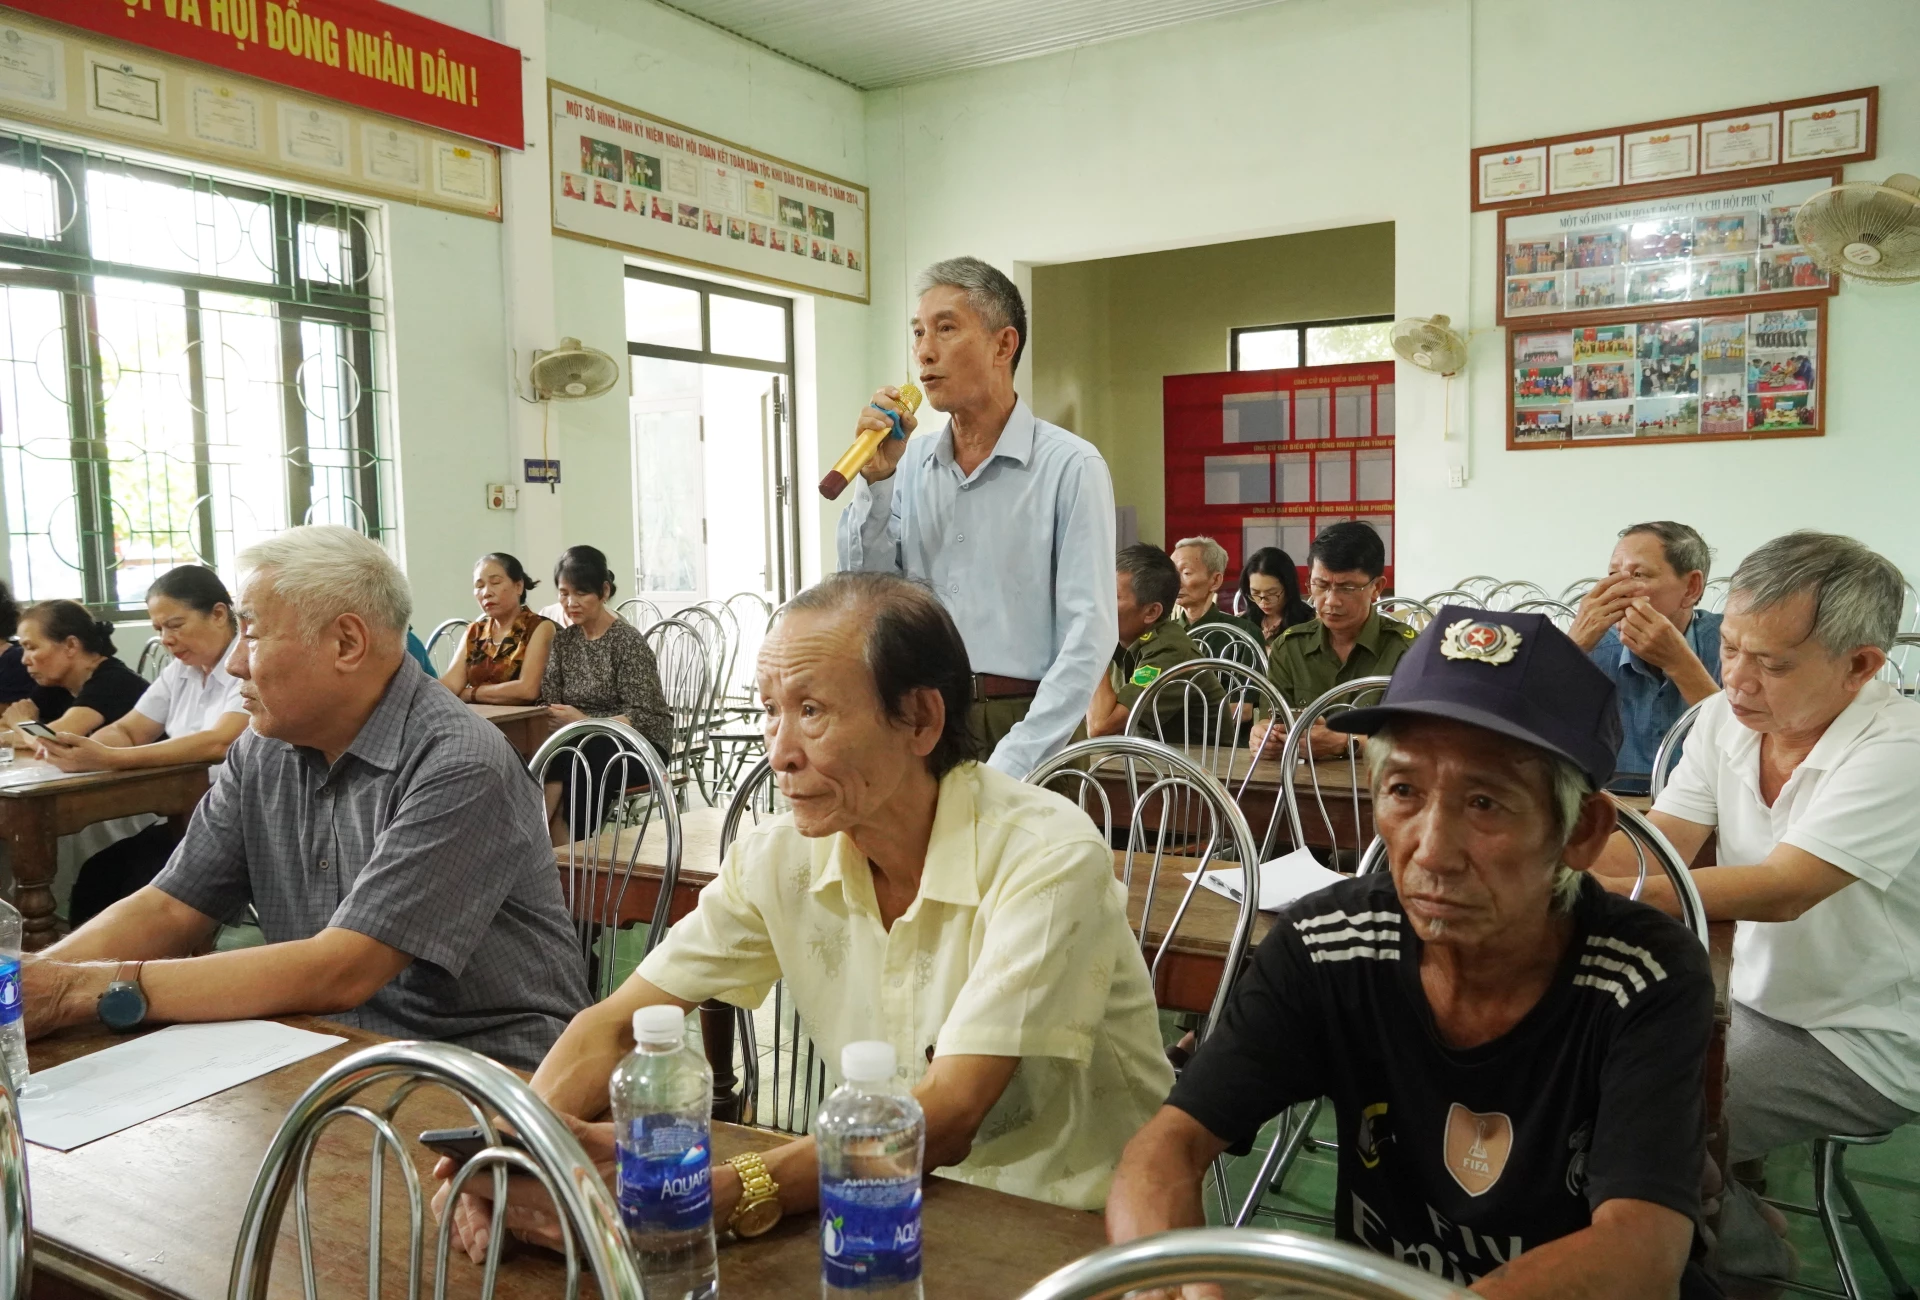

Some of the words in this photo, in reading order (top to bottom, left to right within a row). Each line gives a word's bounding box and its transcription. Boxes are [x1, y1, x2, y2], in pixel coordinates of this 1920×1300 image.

[266, 0, 341, 69] ĐỒNG
[346, 30, 415, 90] NHÂN
[420, 48, 468, 105] DÂN
[566, 100, 583, 120] MỘT
[585, 104, 596, 123] SỐ
[597, 109, 616, 129] HÌNH
[617, 113, 633, 135] ẢNH
[645, 125, 665, 145] NIỆM
[665, 132, 685, 151] NGÀY
[686, 138, 697, 156] HỘI
[698, 143, 716, 160] ĐOÀN
[717, 147, 728, 165] KẾT
[729, 154, 746, 170] TOÀN
[759, 162, 771, 180] TỘC
[771, 168, 783, 182] KHU
[805, 179, 817, 193] KHU
[817, 182, 829, 197] PHỐ
[833, 188, 846, 202] NĂM
[1559, 214, 1578, 229] MỘT
[1580, 211, 1590, 226] SỐ
[1591, 211, 1612, 225] HÌNH
[1614, 207, 1631, 220] ẢNH
[1705, 198, 1721, 212] CHI
[1723, 194, 1739, 210] HỘI
[1741, 194, 1760, 208] PHỤ
[1761, 189, 1775, 204] NỮ
[1305, 441, 1316, 450] HỘI
[1336, 440, 1355, 449] NHÂN
[1304, 504, 1316, 514] HỘI
[1336, 503, 1354, 513] NHÂN
[1463, 1157, 1489, 1174] FIFA
[1425, 1202, 1522, 1265] Fly
